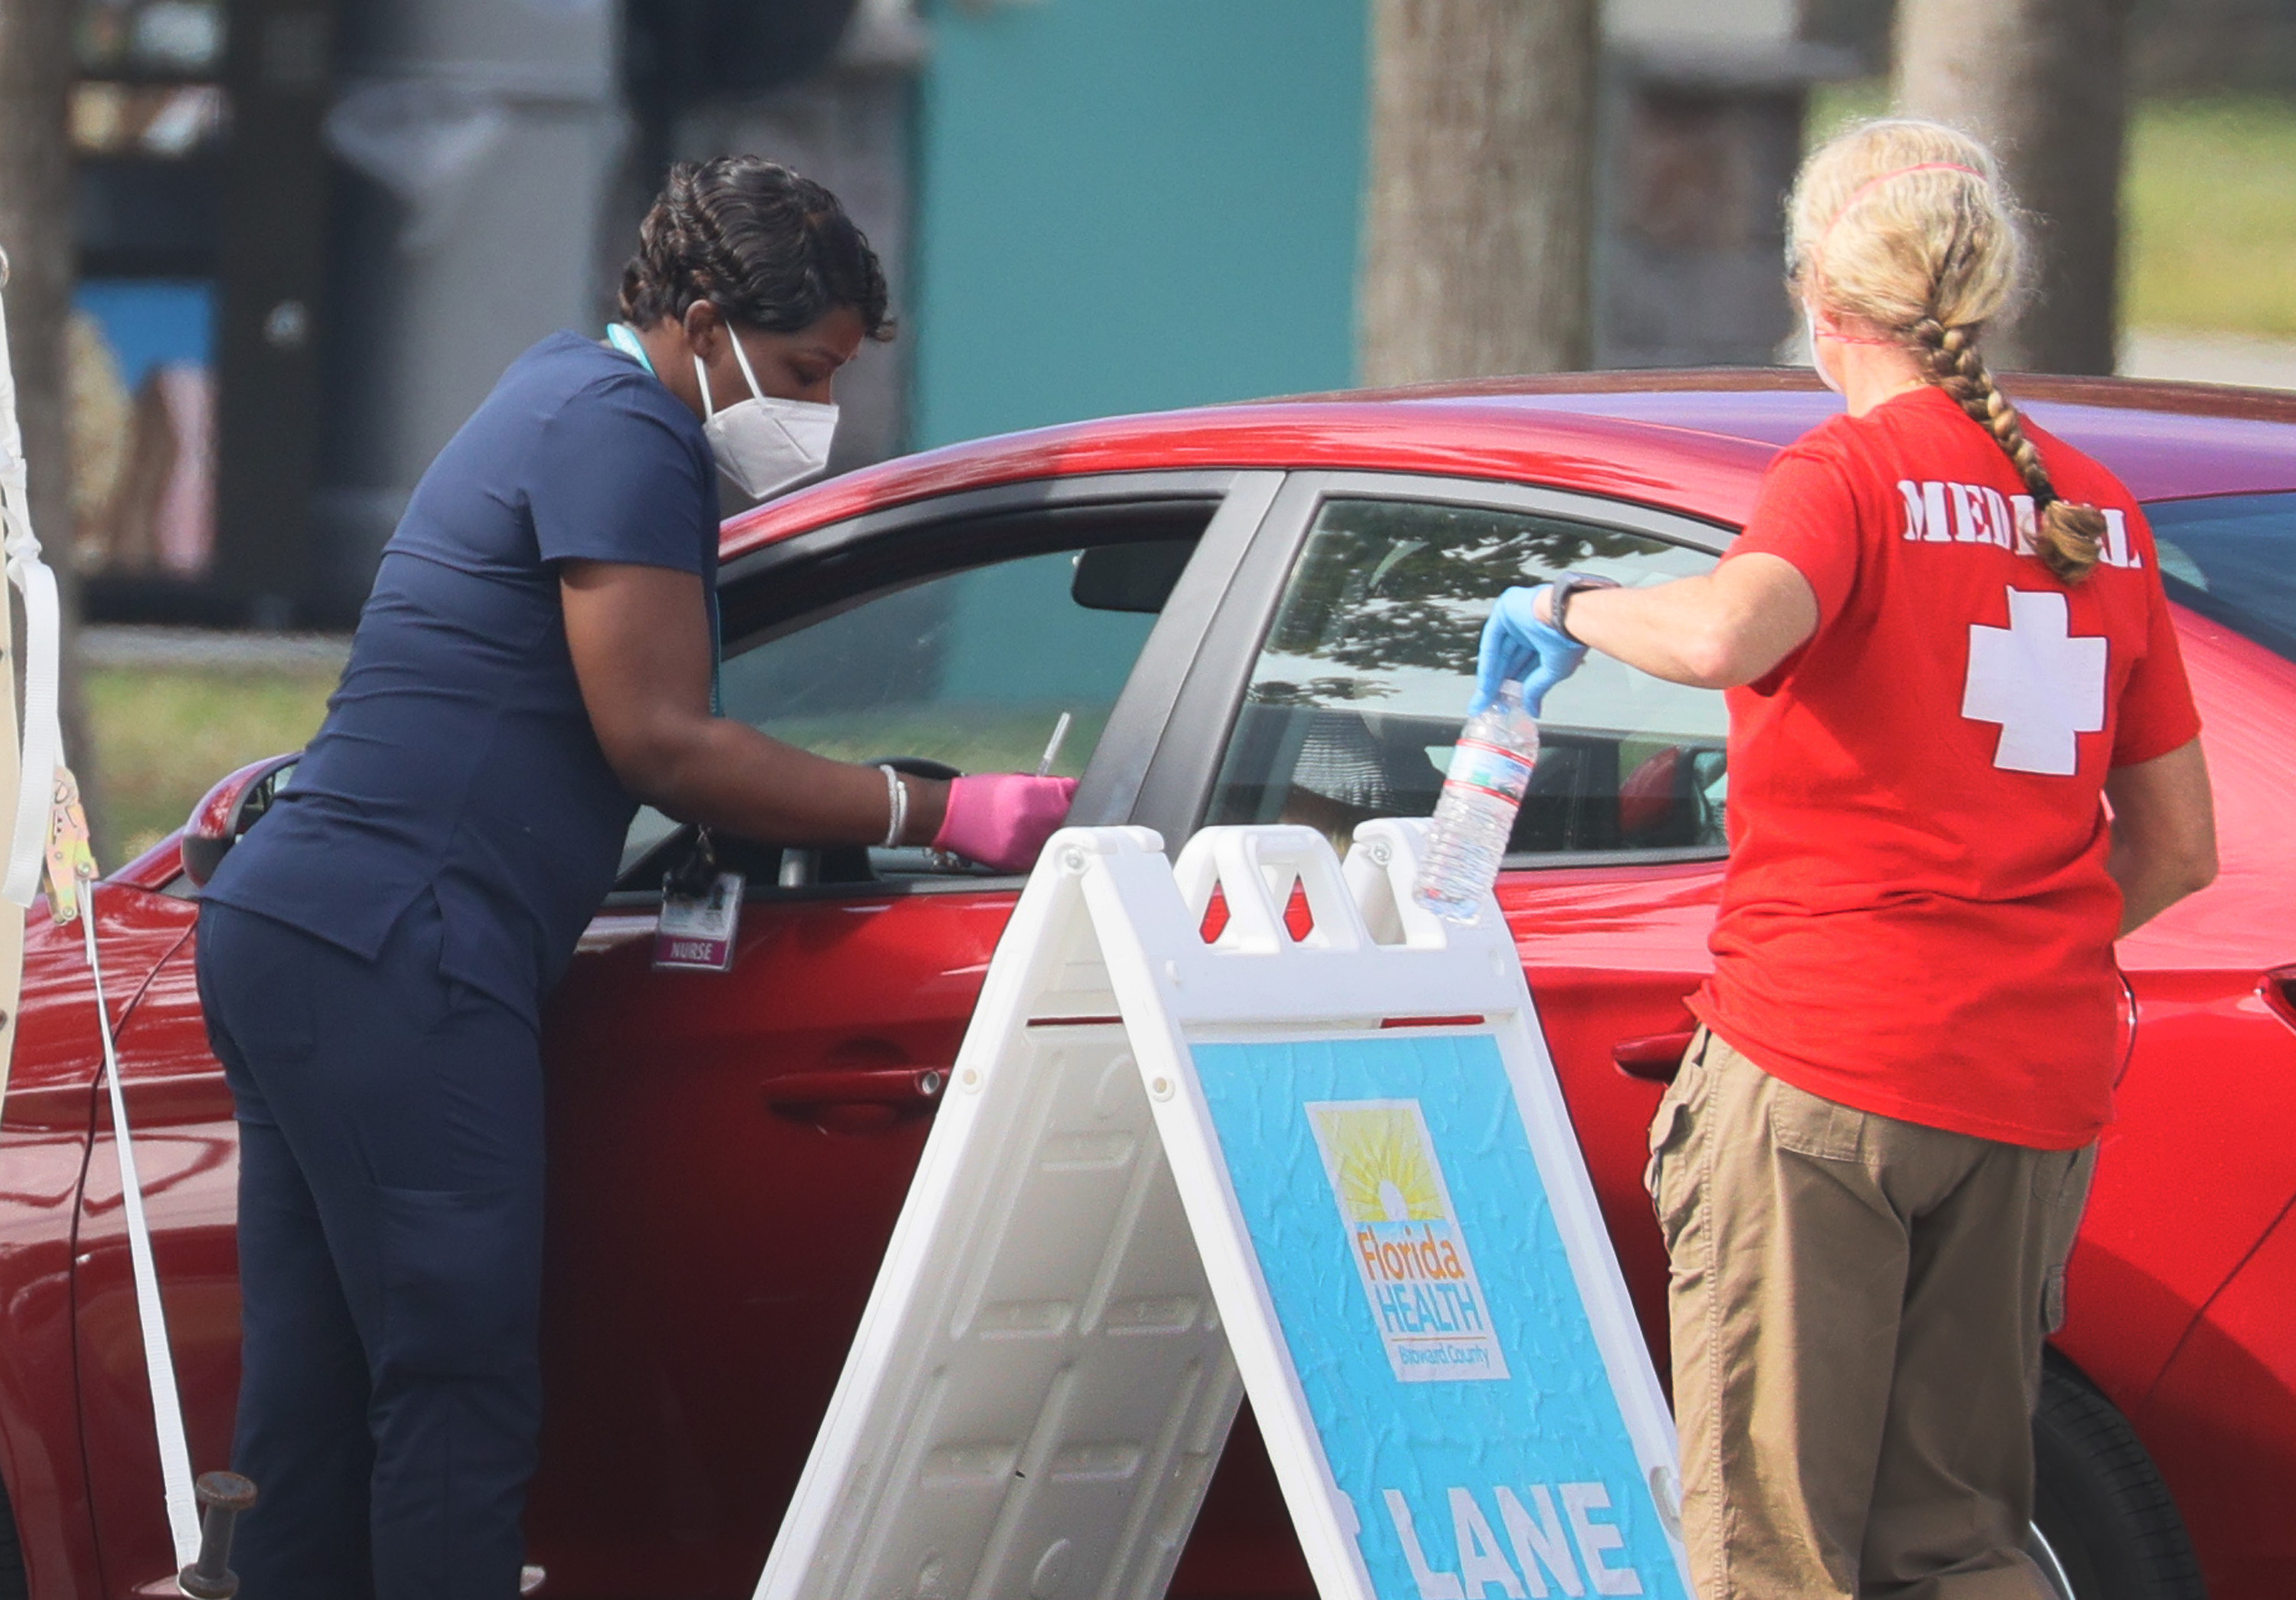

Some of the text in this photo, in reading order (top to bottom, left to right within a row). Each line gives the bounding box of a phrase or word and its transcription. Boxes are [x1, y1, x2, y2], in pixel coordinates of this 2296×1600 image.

[1896, 480, 2142, 568] MEDIL
[670, 942, 713, 960] NURSE
[1357, 1224, 1466, 1281] Florida
[1375, 1283, 1483, 1333] HEALTH
[1399, 1343, 1491, 1369] Broward County
[1383, 1482, 1643, 1599] LANE
